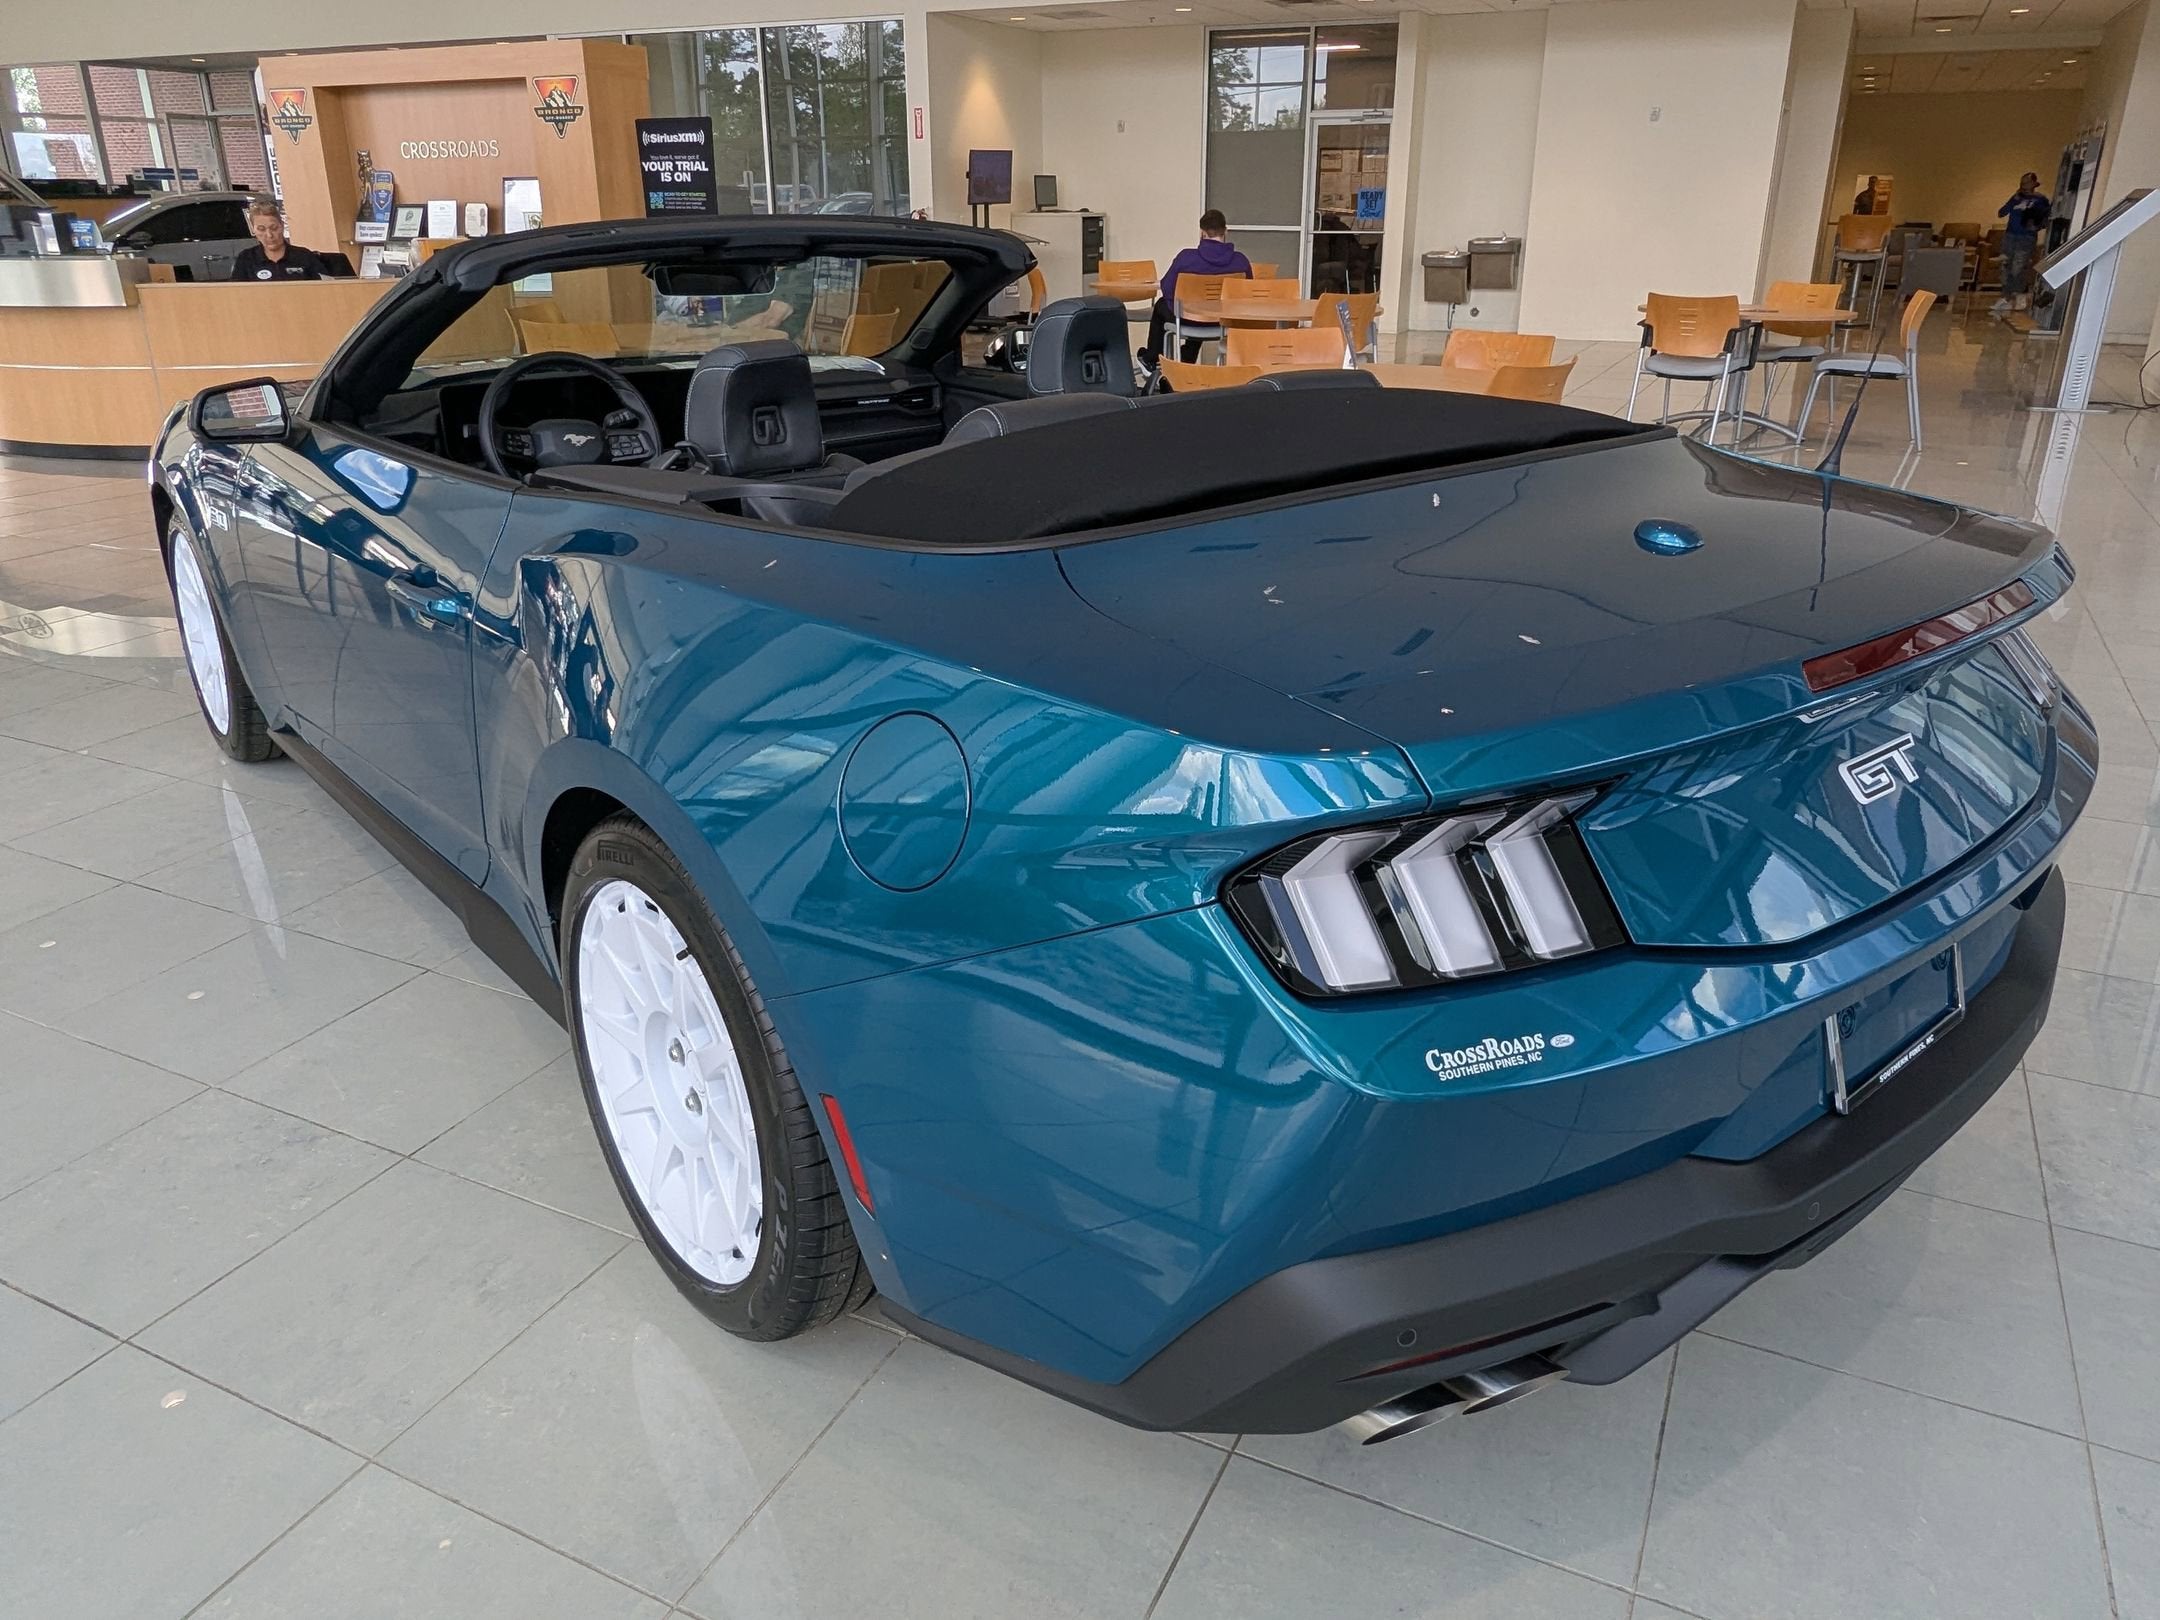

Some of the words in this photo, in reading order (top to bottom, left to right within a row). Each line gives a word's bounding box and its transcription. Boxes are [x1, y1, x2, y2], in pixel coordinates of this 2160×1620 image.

[400, 140, 499, 159] CROSSROADS
[642, 161, 674, 171] YOUR
[675, 161, 709, 171] TRIAL
[660, 172, 672, 182] IS
[673, 172, 692, 182] ON
[1360, 191, 1384, 200] READY
[1365, 199, 1378, 209] SET
[1838, 732, 1920, 806] GT
[597, 839, 635, 866] PIRELLI
[1925, 1033, 1935, 1046] NC
[1438, 1062, 1496, 1082] SOUTHERN
[1495, 1054, 1528, 1070] PINES,
[1527, 1051, 1543, 1063] NC
